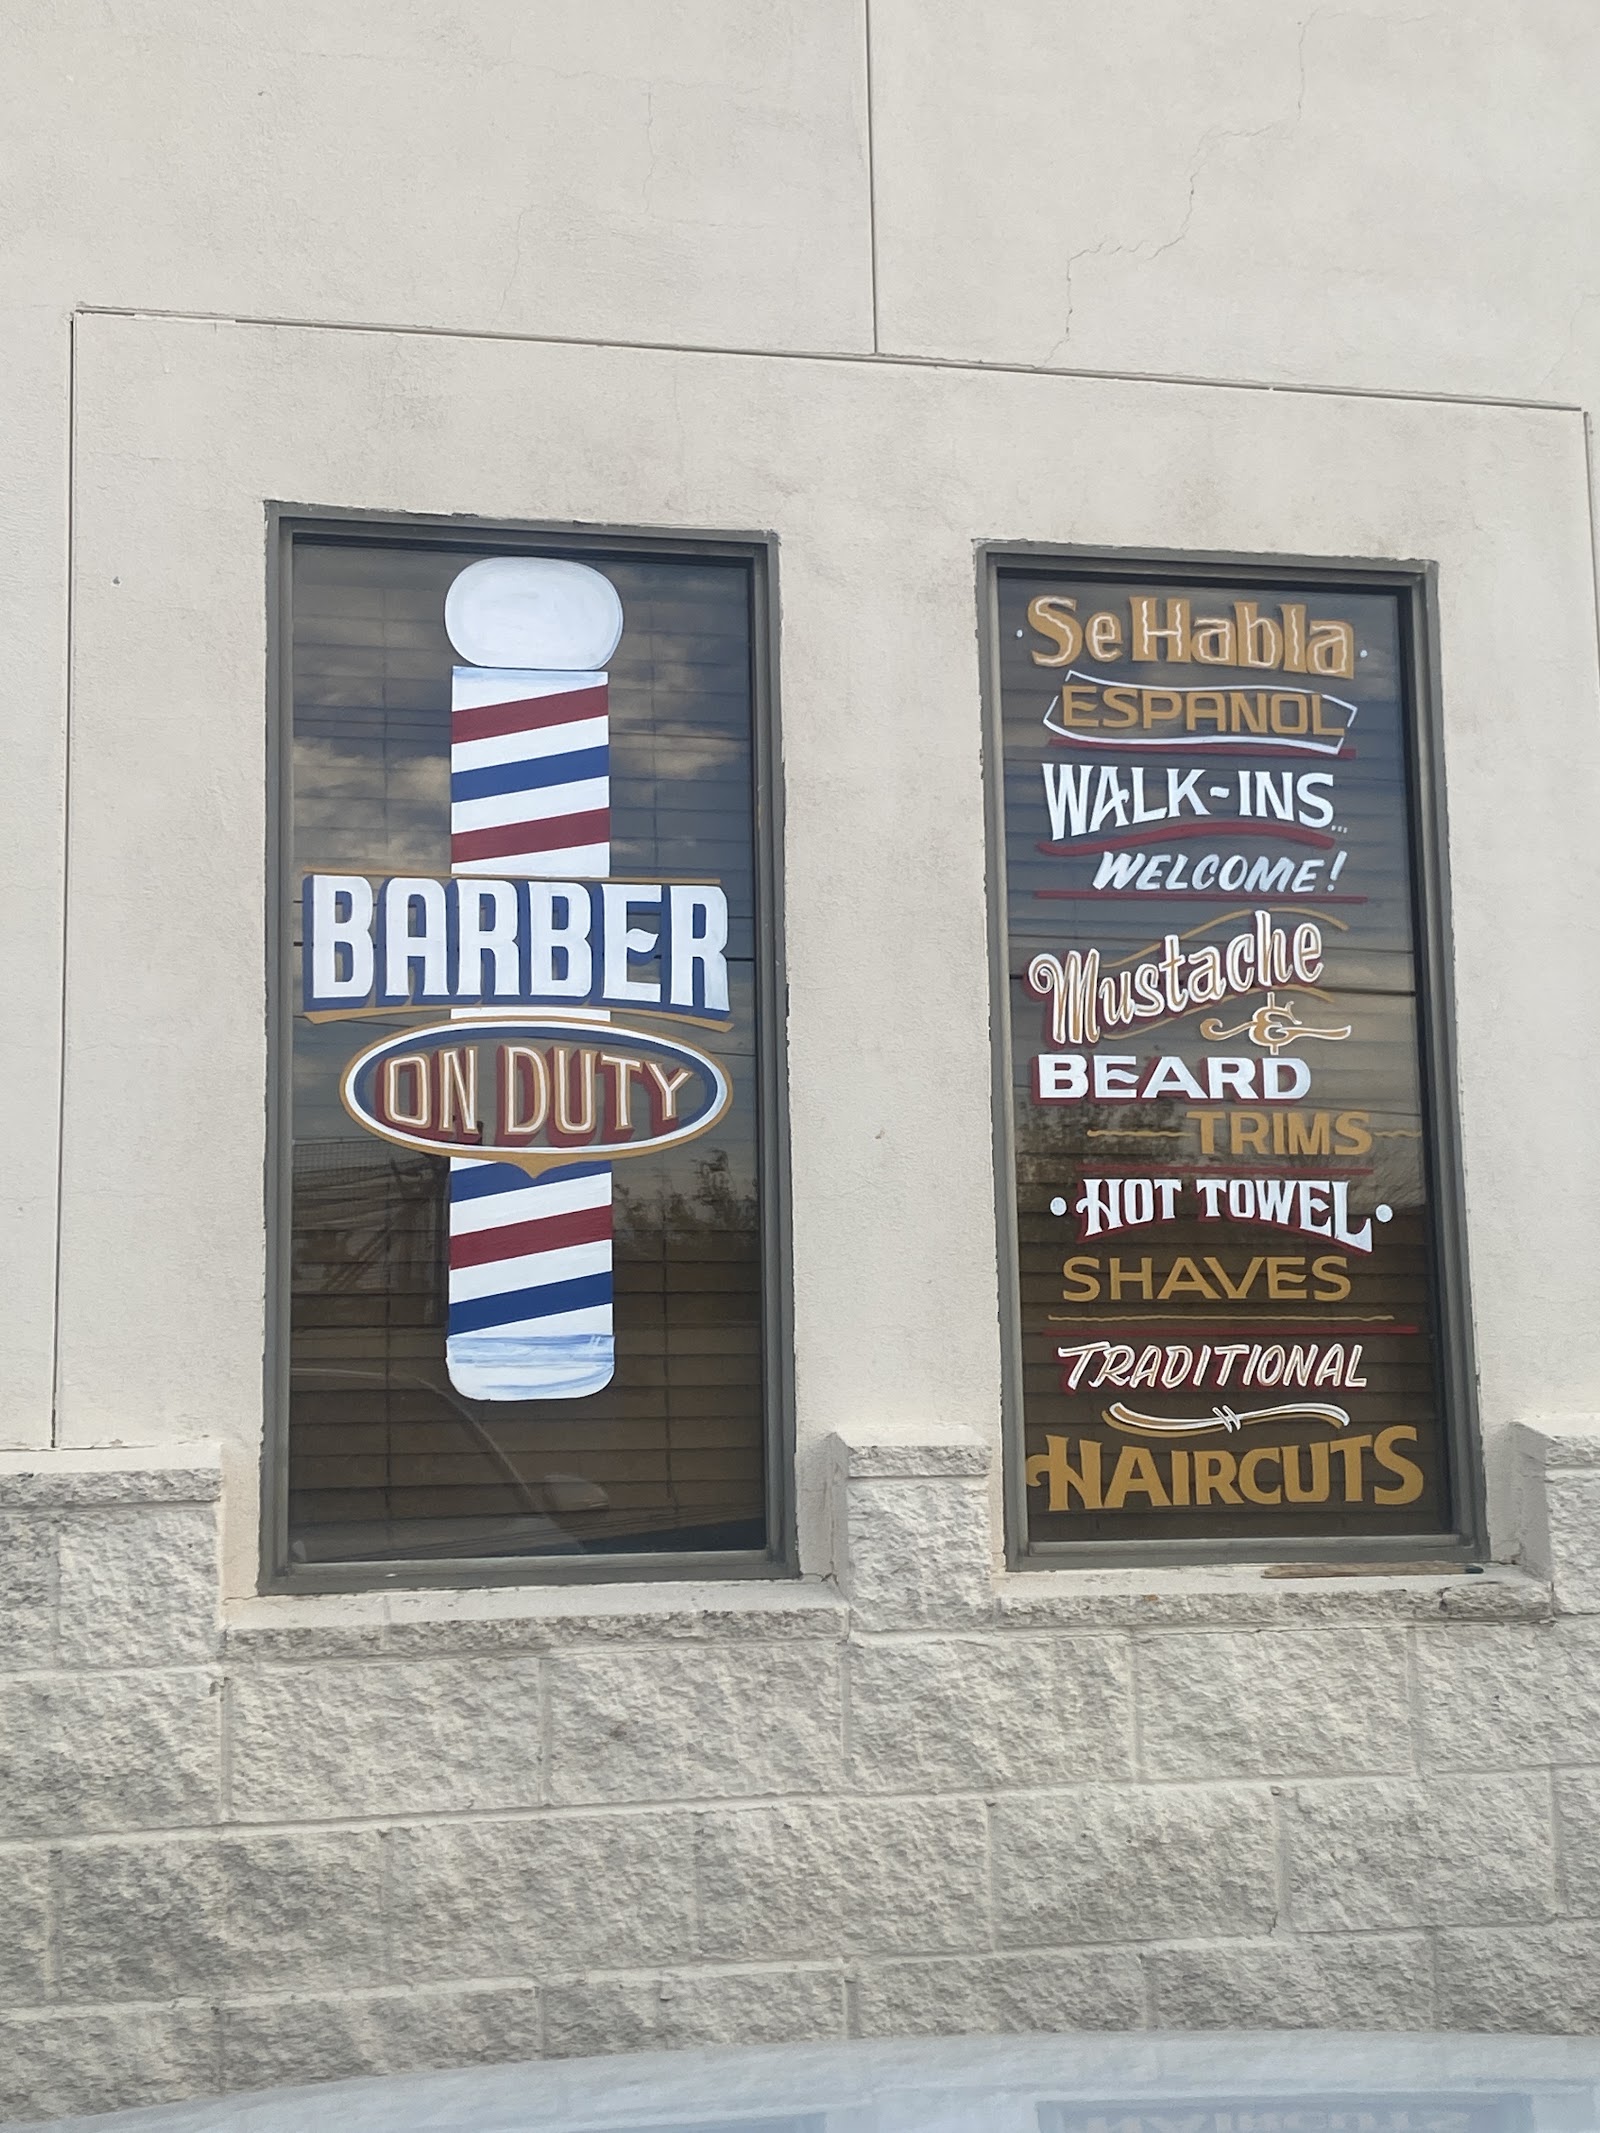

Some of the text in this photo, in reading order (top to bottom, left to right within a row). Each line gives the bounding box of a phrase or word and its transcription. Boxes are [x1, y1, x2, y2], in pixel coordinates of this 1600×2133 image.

[1027, 594, 1355, 680] Se Habla
[1092, 849, 1348, 894] WELCOME!
[306, 874, 732, 1014] BARBER
[1027, 908, 1326, 1046] Mustache
[1199, 991, 1353, 1056] &
[380, 1044, 693, 1143] ON DUTY
[1036, 1053, 1312, 1101] BEARD
[1186, 1110, 1374, 1156] TRIMS
[1075, 1177, 1374, 1254] HOT TOWEL
[1061, 1254, 1353, 1302] SHAVES
[1056, 1340, 1369, 1391] TRADITIONAL
[1025, 1425, 1425, 1513] HAIRCUTS
